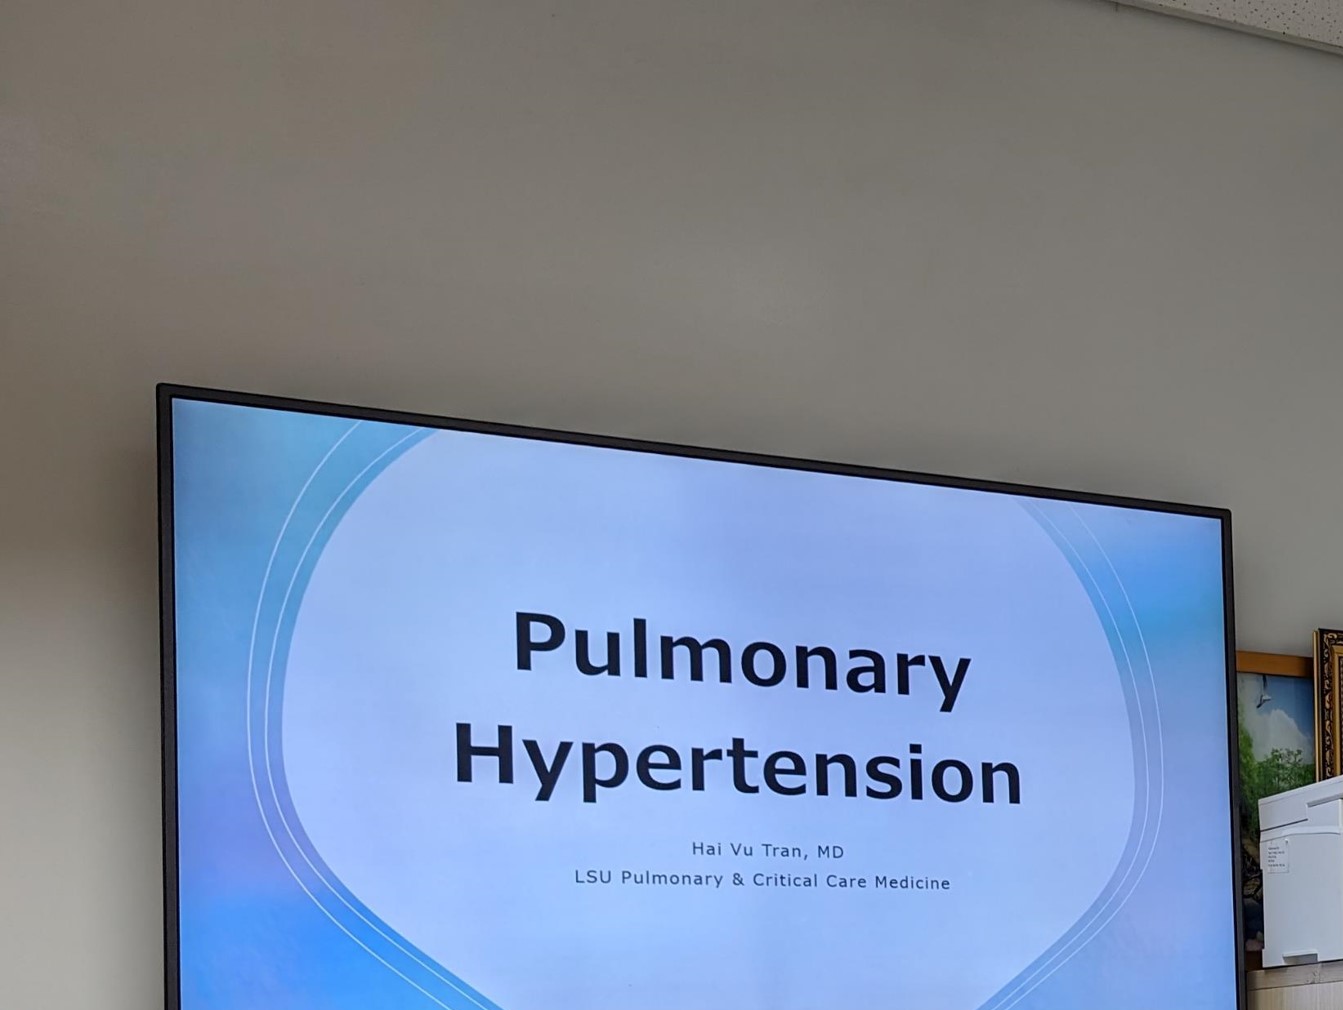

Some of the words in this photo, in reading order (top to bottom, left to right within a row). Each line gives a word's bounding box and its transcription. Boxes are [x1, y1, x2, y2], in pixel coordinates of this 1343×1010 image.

[515, 611, 972, 713] Pulmonary
[455, 722, 1022, 804] Hypertension
[692, 841, 722, 856] Hai
[730, 842, 753, 857] Vu
[761, 843, 808, 861] Tran,
[817, 844, 844, 859] MD
[575, 869, 612, 884] LSU
[621, 870, 724, 888] Pulmonary
[732, 872, 745, 887] &
[753, 873, 818, 888] Critical
[826, 874, 867, 889] Care
[875, 875, 950, 890] Medicine
